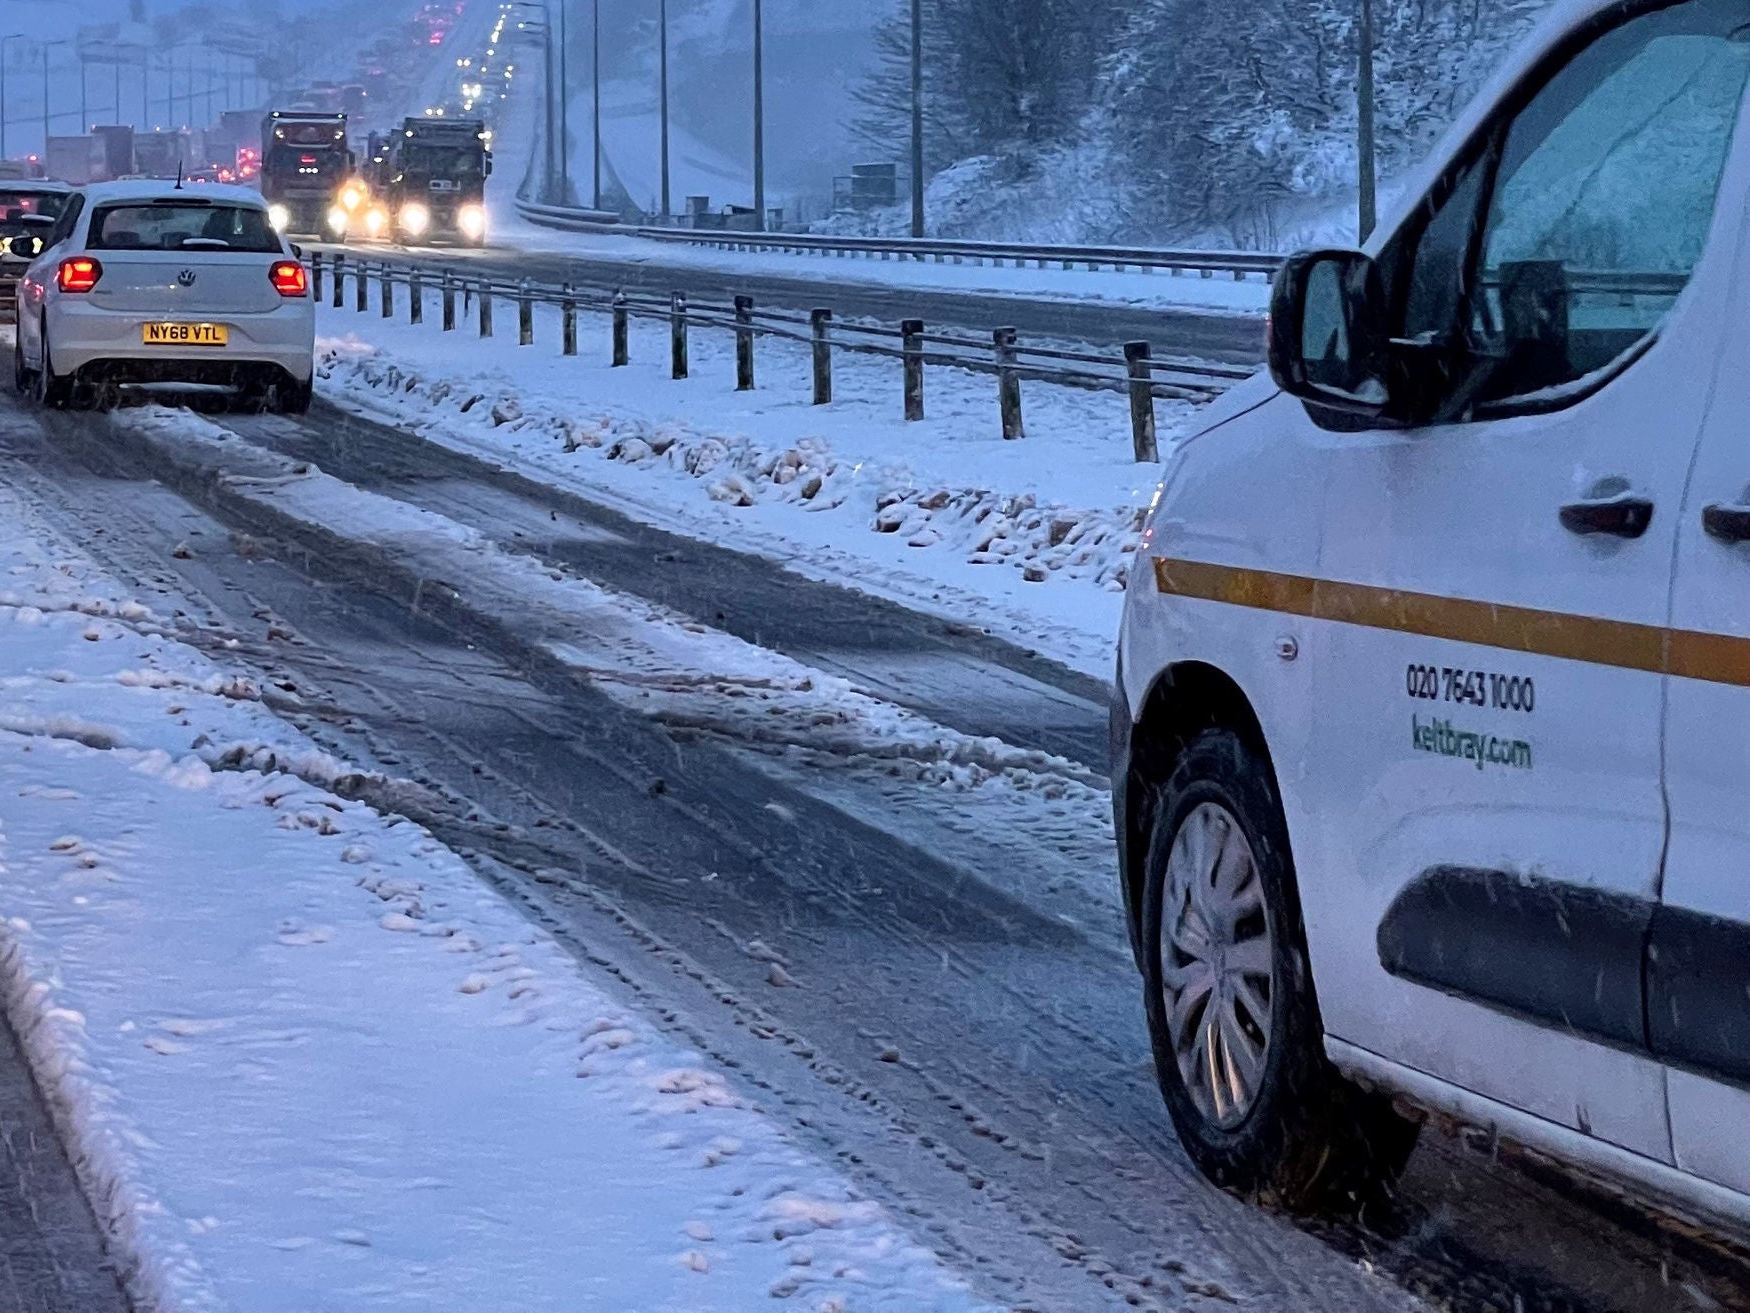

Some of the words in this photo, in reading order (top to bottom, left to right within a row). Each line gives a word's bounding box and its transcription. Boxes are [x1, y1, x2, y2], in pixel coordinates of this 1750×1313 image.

[149, 325, 189, 340] NY68
[192, 326, 222, 341] VTL
[1406, 664, 1439, 700] 020
[1441, 667, 1486, 707] 7643
[1489, 673, 1534, 712] 1000
[1412, 712, 1533, 771] keltbray.com
